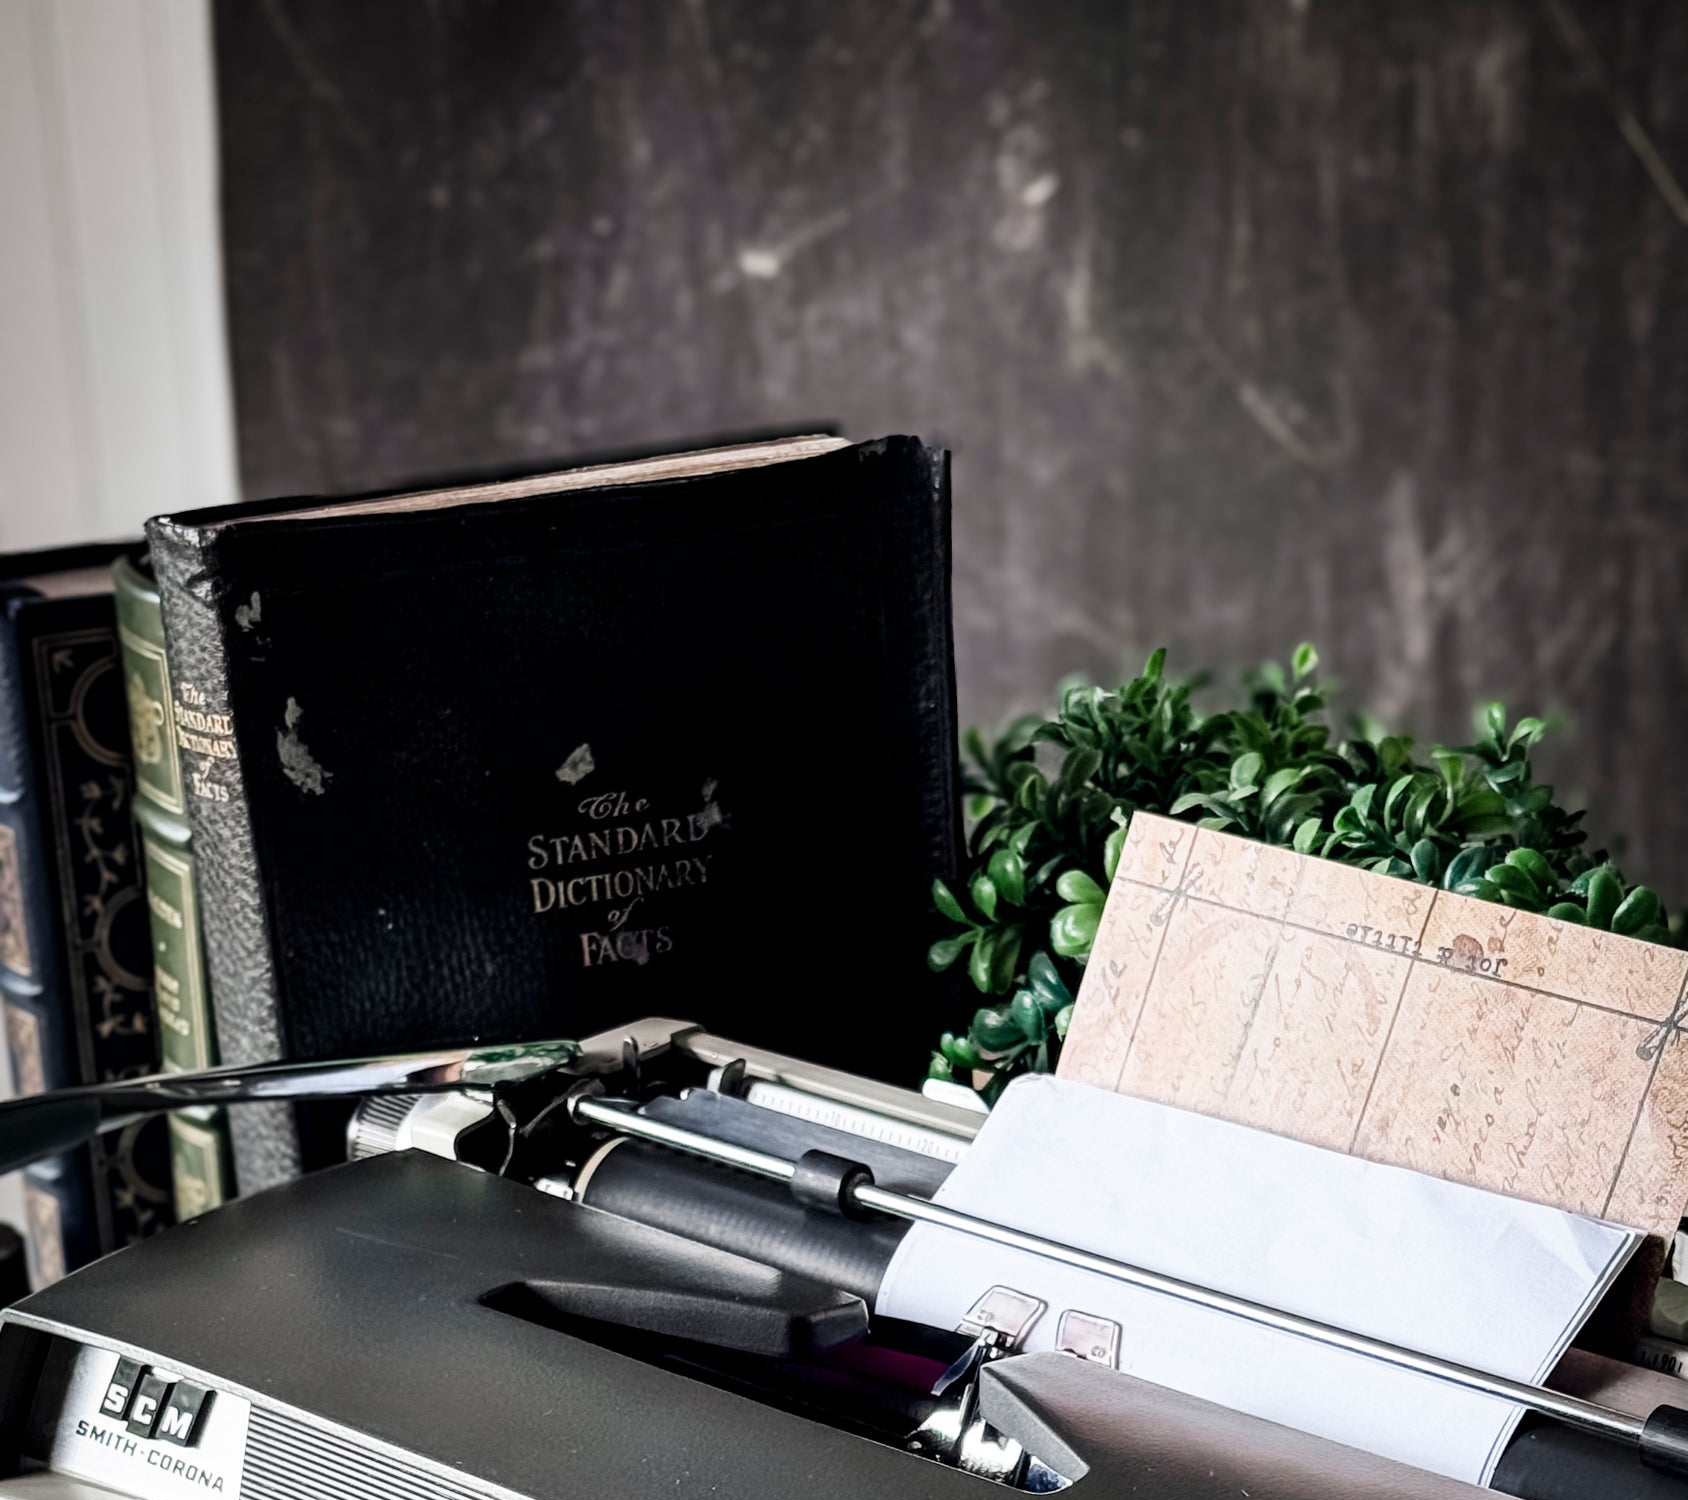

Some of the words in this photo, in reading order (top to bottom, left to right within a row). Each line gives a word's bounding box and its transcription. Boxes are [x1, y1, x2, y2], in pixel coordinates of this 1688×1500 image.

[181, 681, 206, 706] The
[577, 791, 650, 820] The
[527, 814, 710, 871] STANDARD
[529, 854, 713, 914] DICTIONARY
[607, 897, 645, 932] of
[579, 926, 673, 968] FACTS
